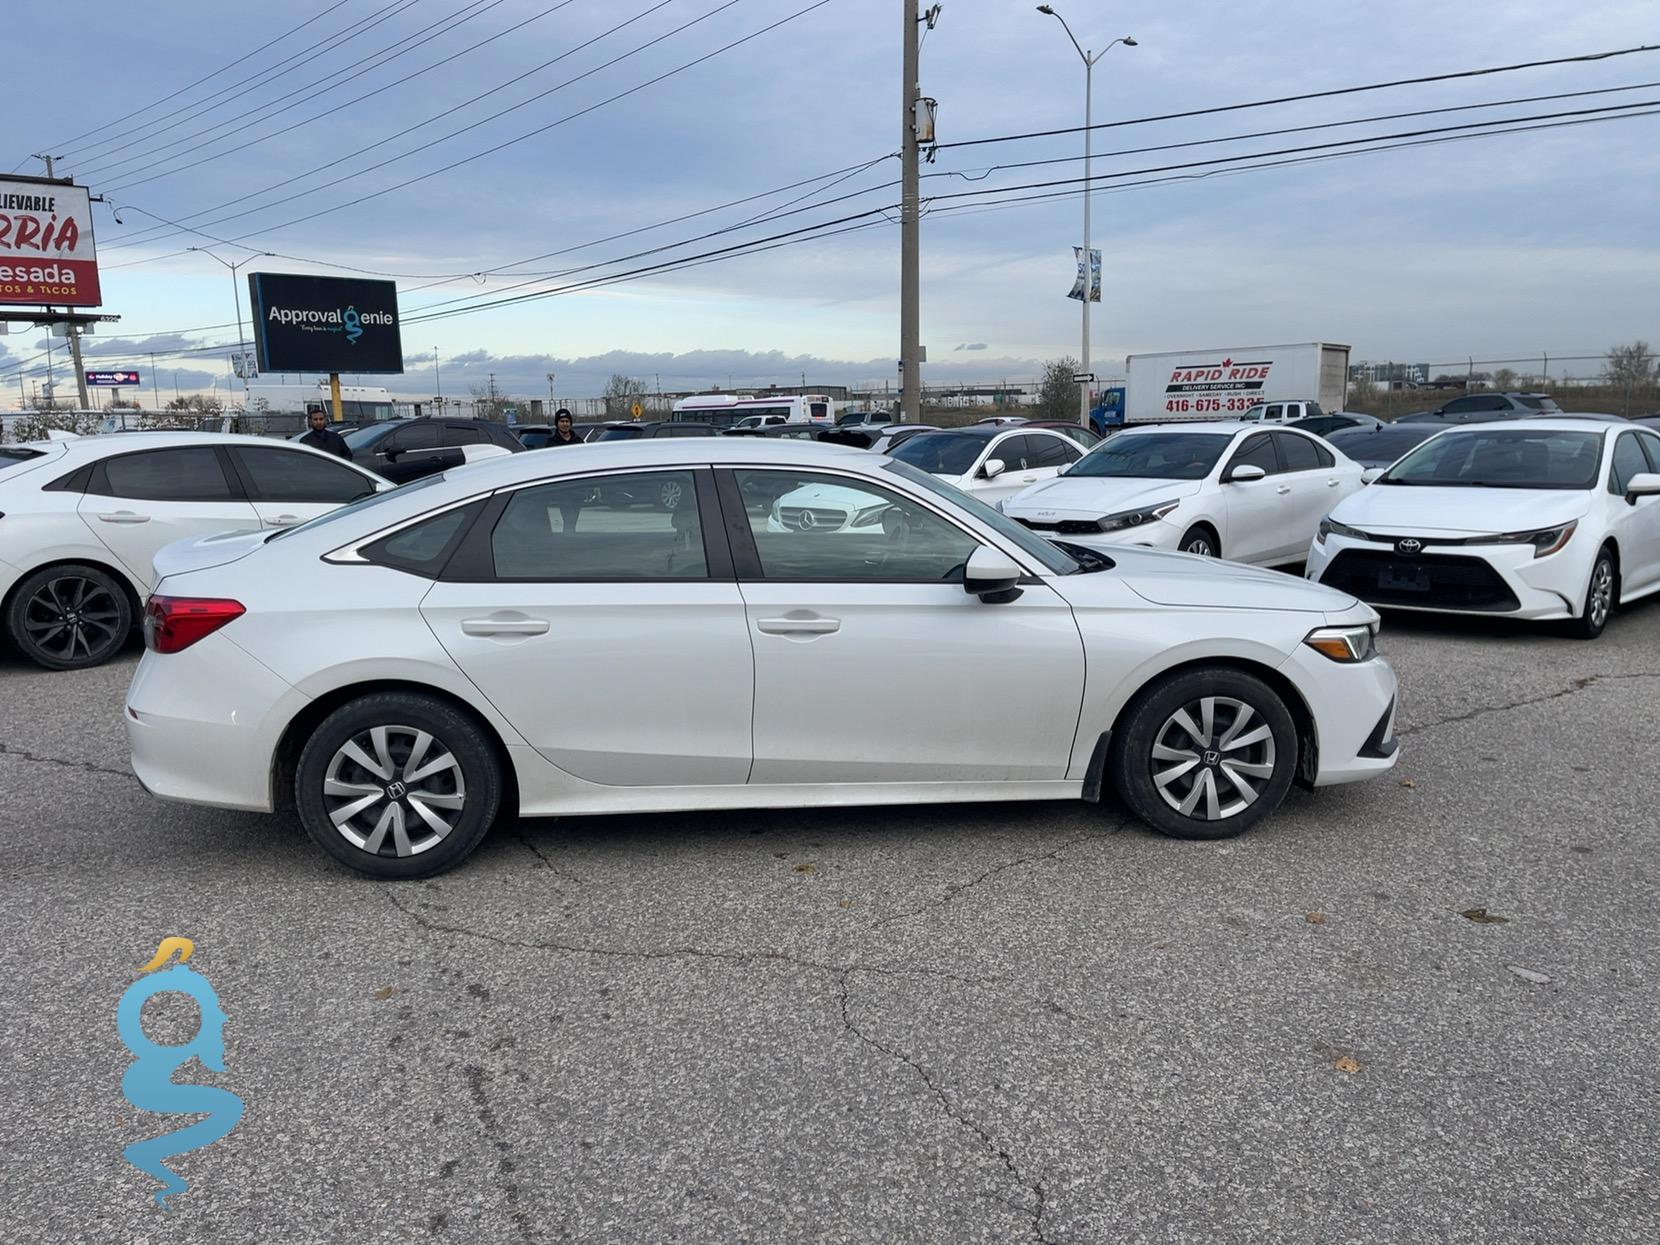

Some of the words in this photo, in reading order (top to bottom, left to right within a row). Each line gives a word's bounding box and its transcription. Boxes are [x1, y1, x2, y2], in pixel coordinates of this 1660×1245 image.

[0, 264, 75, 284] esada
[27, 285, 34, 293] &
[40, 286, 77, 295] TACOS
[1170, 369, 1222, 382] RAPID
[1228, 367, 1270, 380] RIDE
